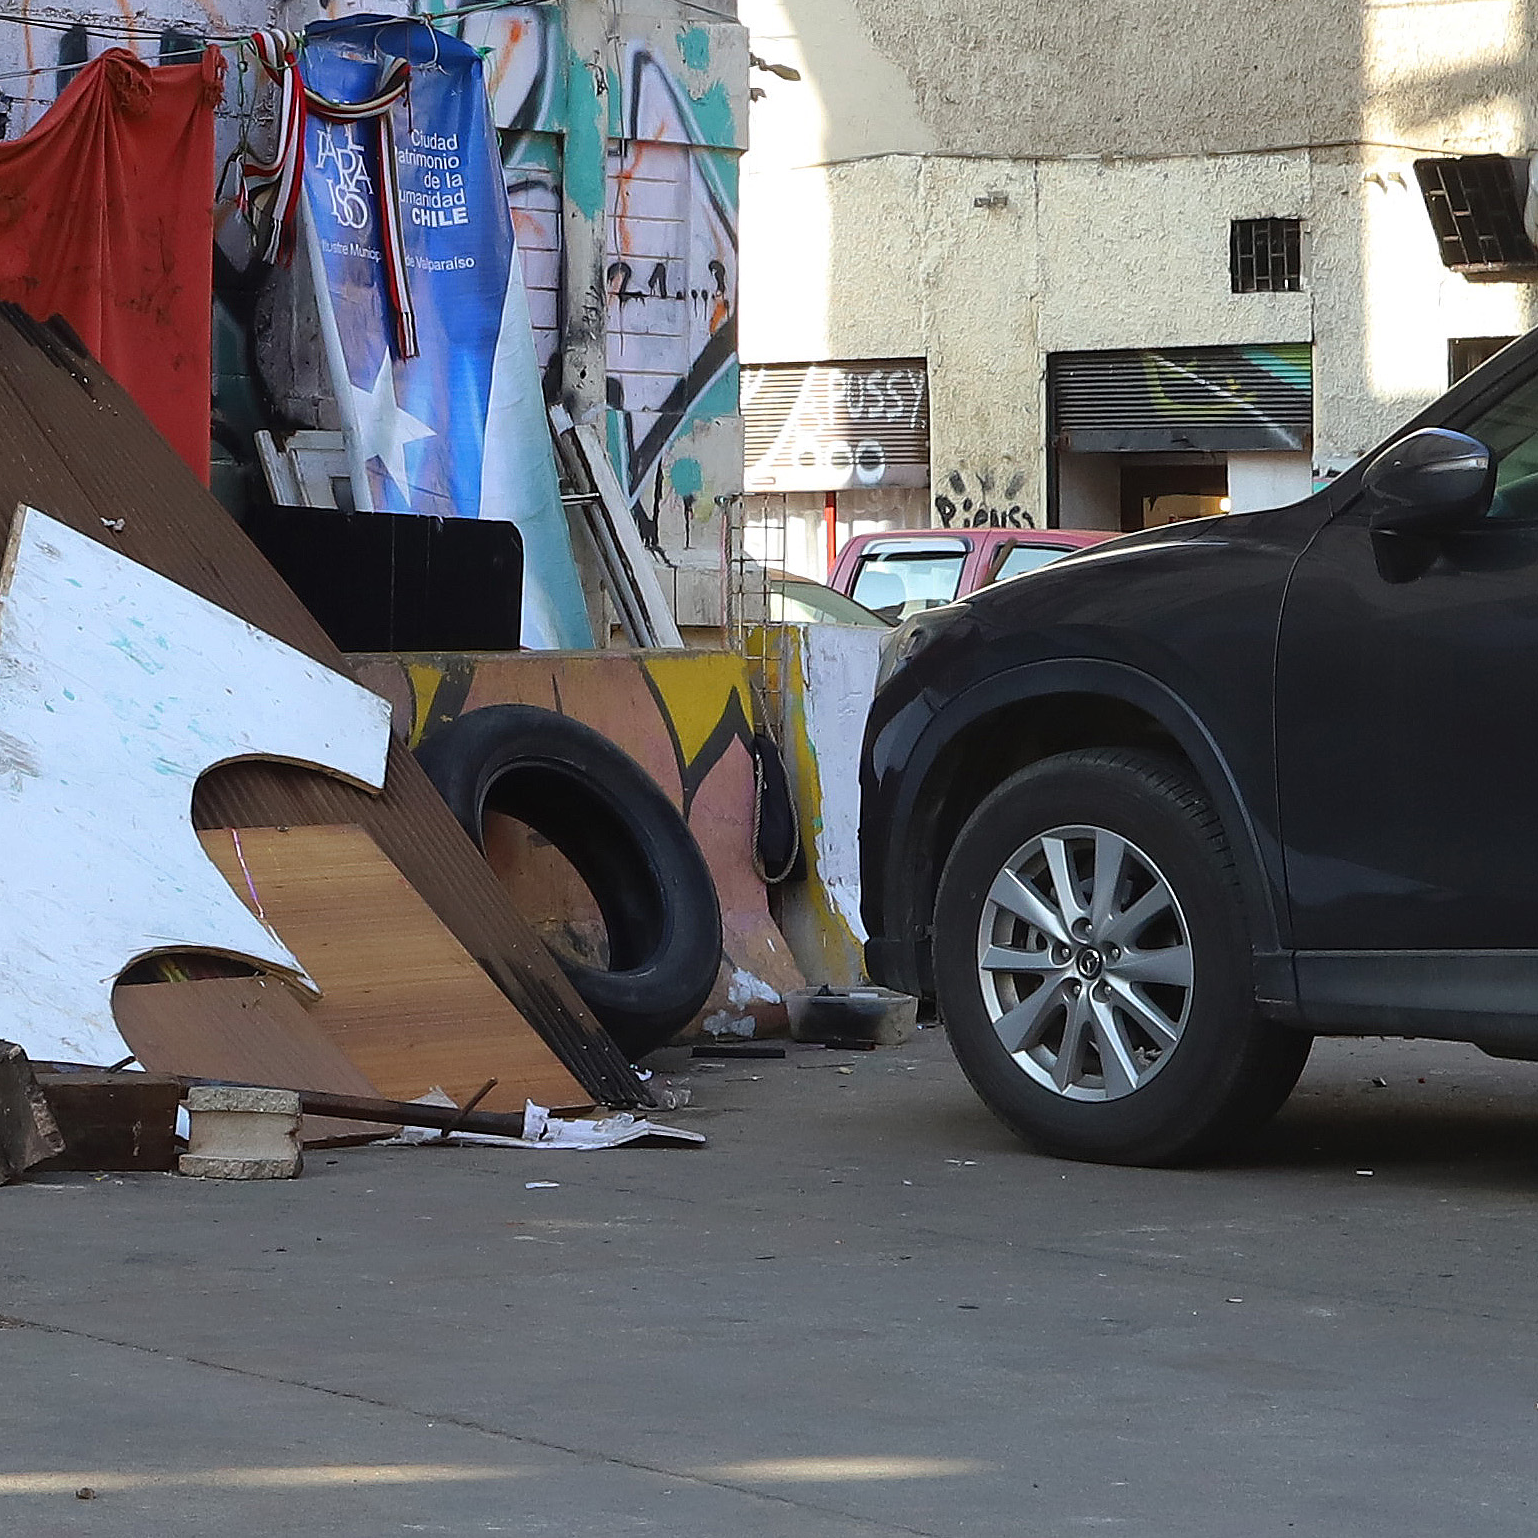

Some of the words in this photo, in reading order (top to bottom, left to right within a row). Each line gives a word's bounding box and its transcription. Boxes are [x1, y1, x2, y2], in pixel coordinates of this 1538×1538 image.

[411, 128, 459, 151] Ciudad
[394, 146, 461, 170] atrimonio
[424, 171, 441, 189] de
[446, 172, 464, 188] la
[399, 188, 466, 209] umanidad
[411, 207, 470, 229] CHILE
